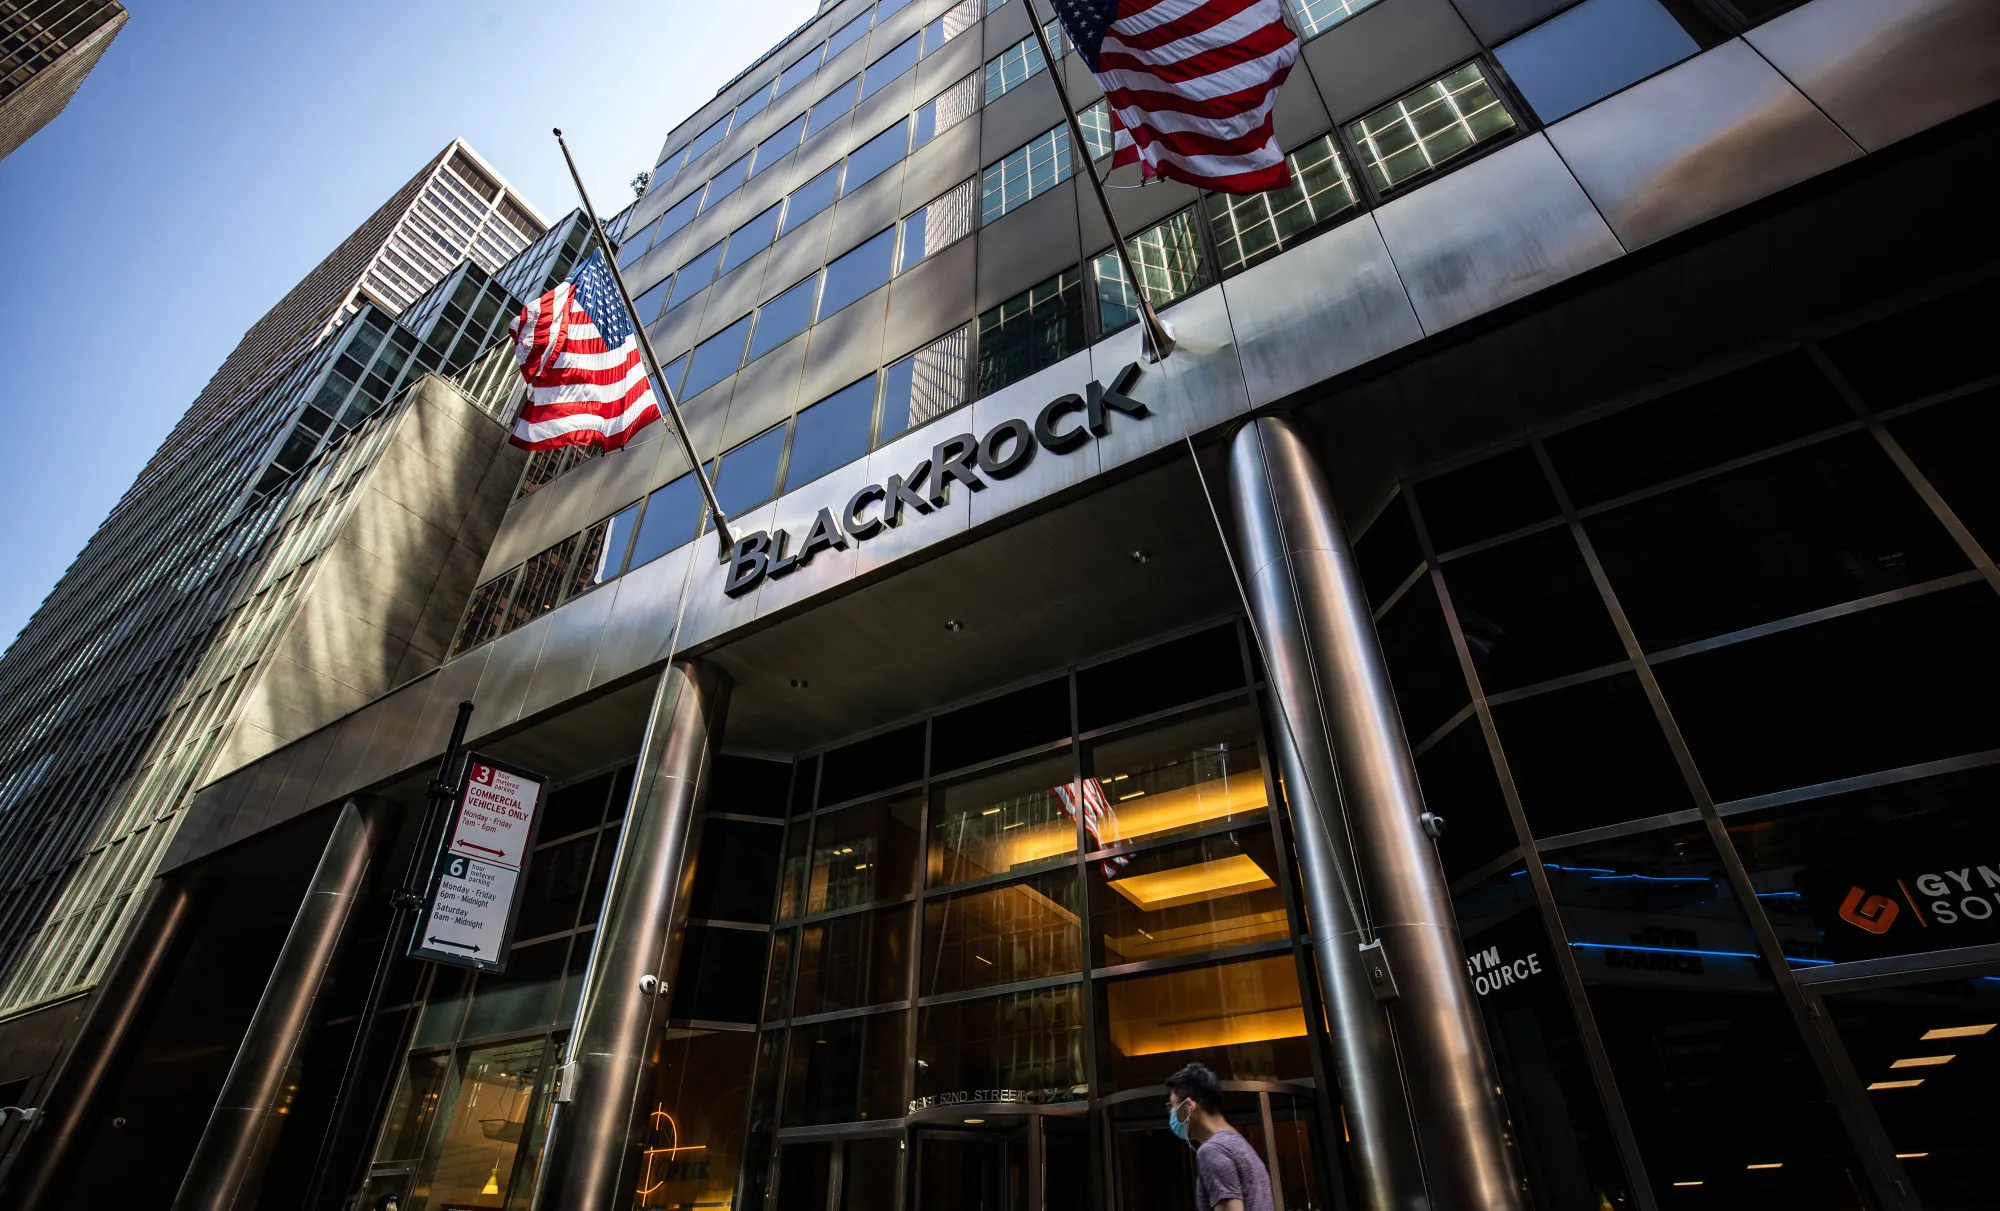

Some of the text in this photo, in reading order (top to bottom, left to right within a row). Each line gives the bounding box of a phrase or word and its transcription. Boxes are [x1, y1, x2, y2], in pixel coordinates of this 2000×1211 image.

[724, 361, 1148, 599] BLACKROCK
[476, 766, 490, 783] 3
[498, 771, 510, 780] hour
[494, 785, 515, 796] parking
[496, 779, 520, 790] metered
[470, 787, 522, 810] COMMERCIAL
[468, 796, 529, 821] VEHICLES ONLY
[462, 817, 475, 827] 7am
[481, 823, 497, 833] 6pm
[463, 809, 488, 823] Monday
[493, 818, 512, 830] Friday
[450, 858, 464, 876] 6
[470, 870, 495, 881] metered
[471, 863, 485, 871] hour
[468, 876, 491, 887] parking
[440, 890, 456, 900] 6pm
[461, 895, 489, 908] Midnight
[442, 881, 470, 894] Monday
[475, 889, 497, 901] Friday
[436, 902, 469, 917] Saturday
[1931, 891, 2000, 925] SO
[433, 911, 449, 922] 8am
[454, 916, 483, 929] Midnight
[1475, 952, 1543, 995] OURCE
[939, 1091, 968, 1105] 52ND
[974, 1089, 1026, 1102] STREET
